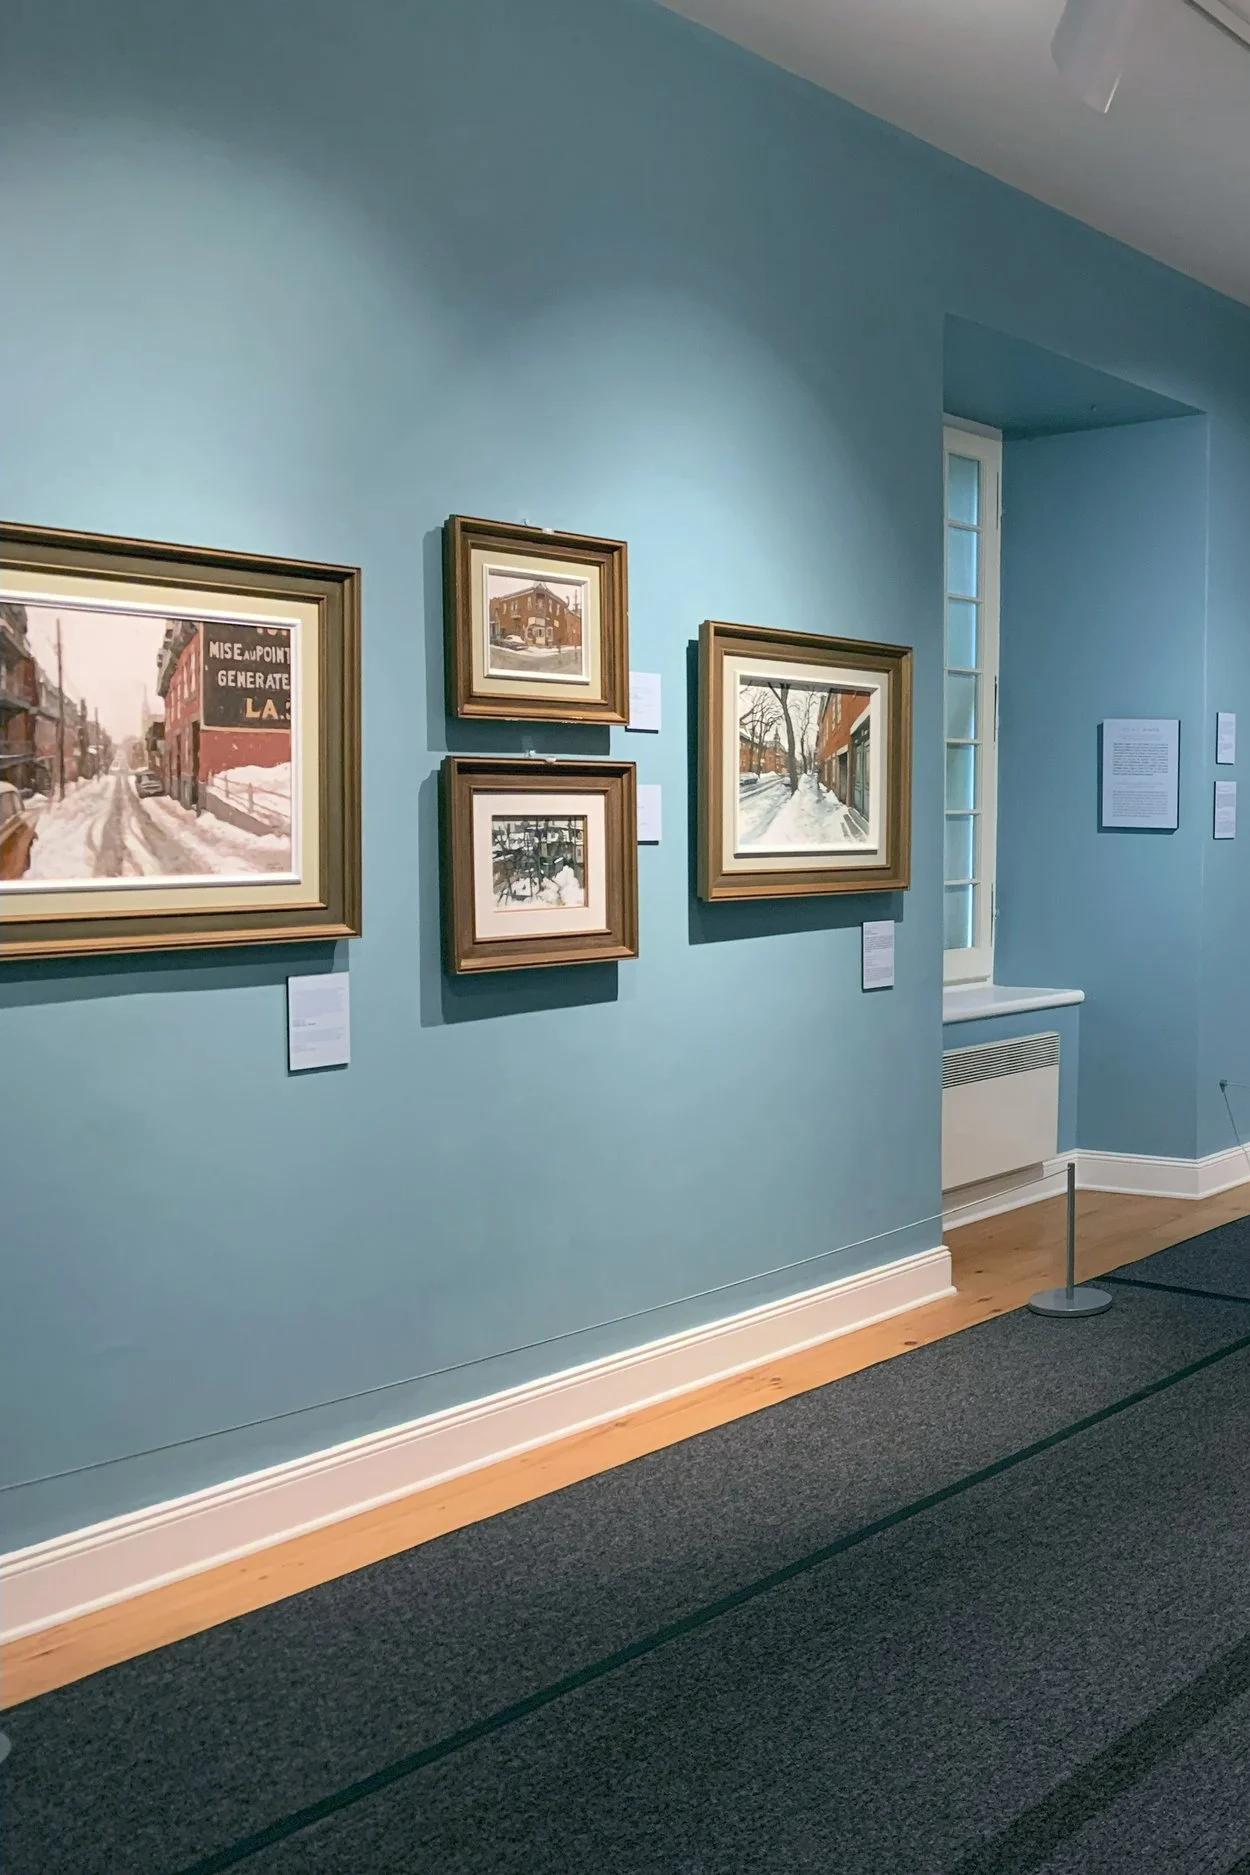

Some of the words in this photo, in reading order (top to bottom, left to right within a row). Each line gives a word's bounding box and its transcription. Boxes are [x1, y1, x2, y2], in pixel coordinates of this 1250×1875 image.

[209, 641, 243, 661] MISE
[256, 645, 291, 665] POINT
[217, 669, 291, 690] GENERATE
